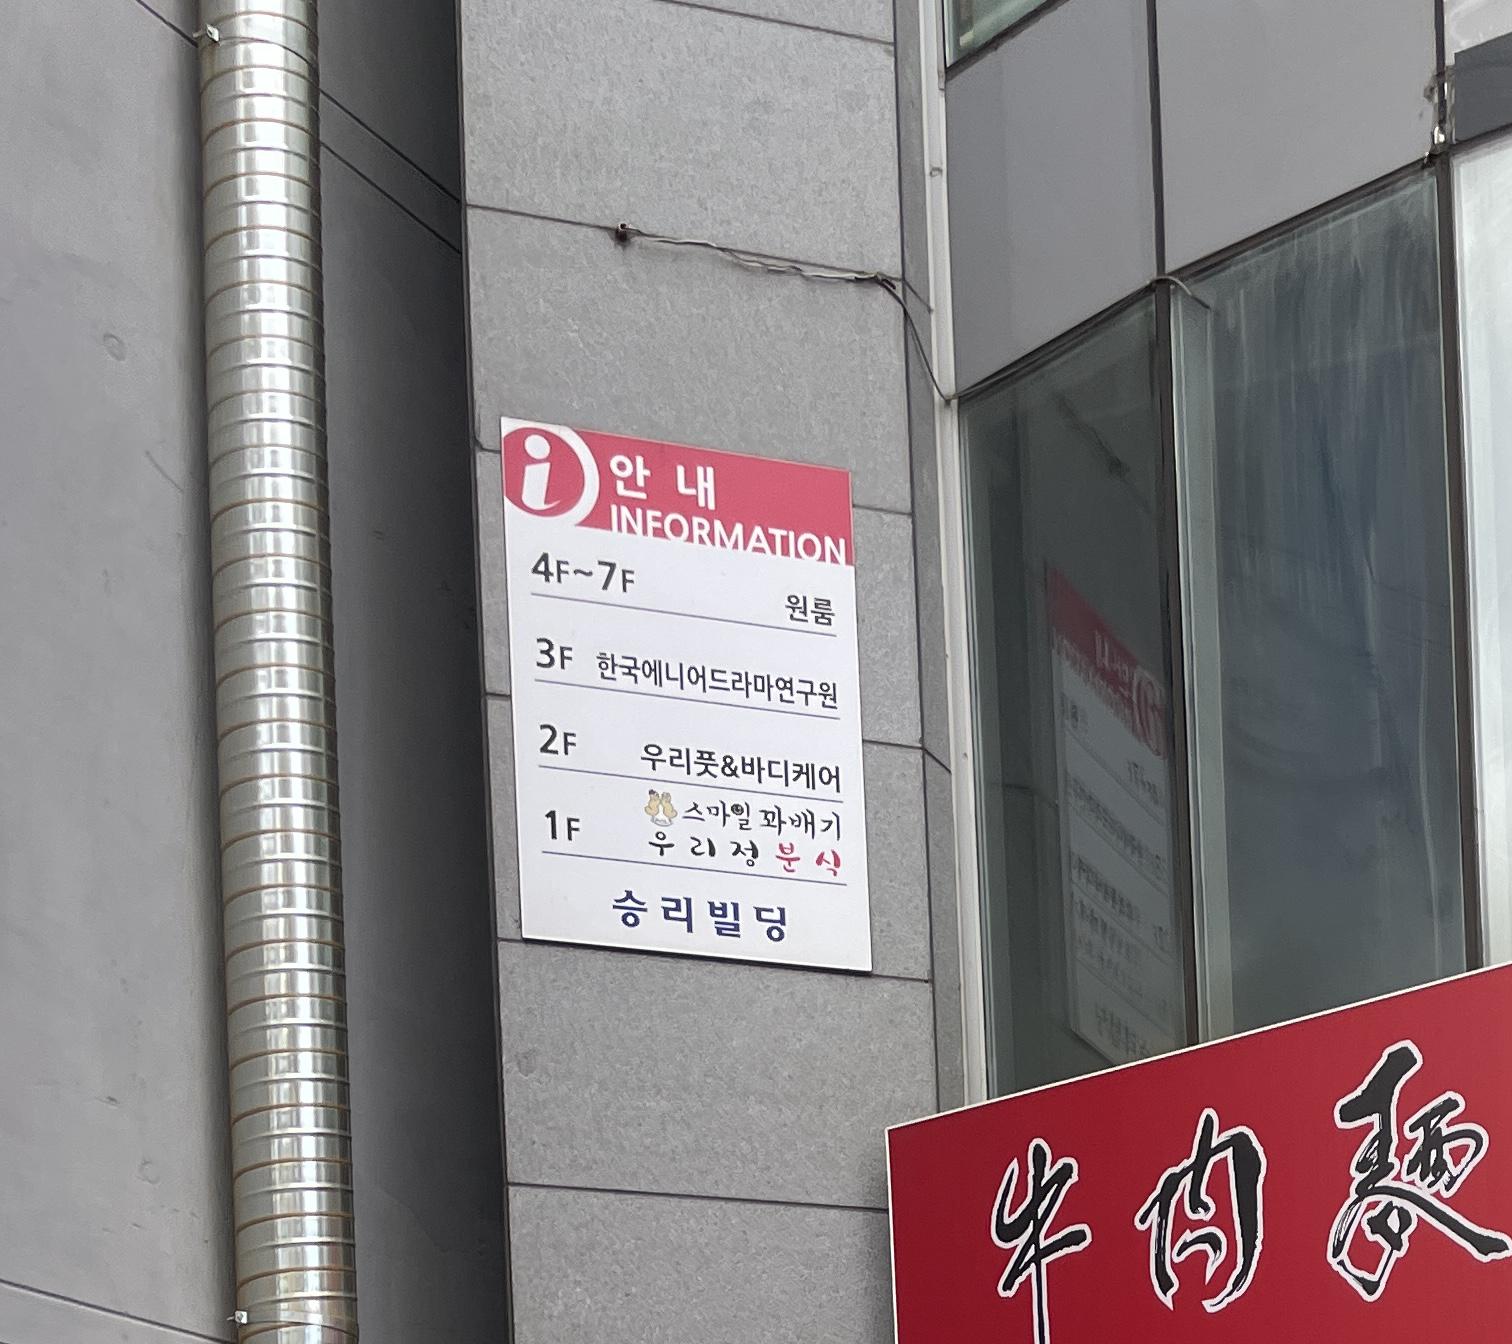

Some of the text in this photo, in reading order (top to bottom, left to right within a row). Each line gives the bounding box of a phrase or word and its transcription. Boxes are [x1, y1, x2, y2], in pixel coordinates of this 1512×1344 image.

[610, 504, 846, 566] INFORMATION
[531, 552, 635, 593] 4F~7F
[785, 594, 836, 627] 원룸
[536, 637, 573, 670] 3F
[596, 651, 838, 710] 한국에니어드라마연구원
[539, 723, 577, 757] 2F
[640, 743, 841, 794] 우리풋&바디케어
[544, 809, 580, 841] 1F
[612, 889, 787, 942] 승리빌딩
